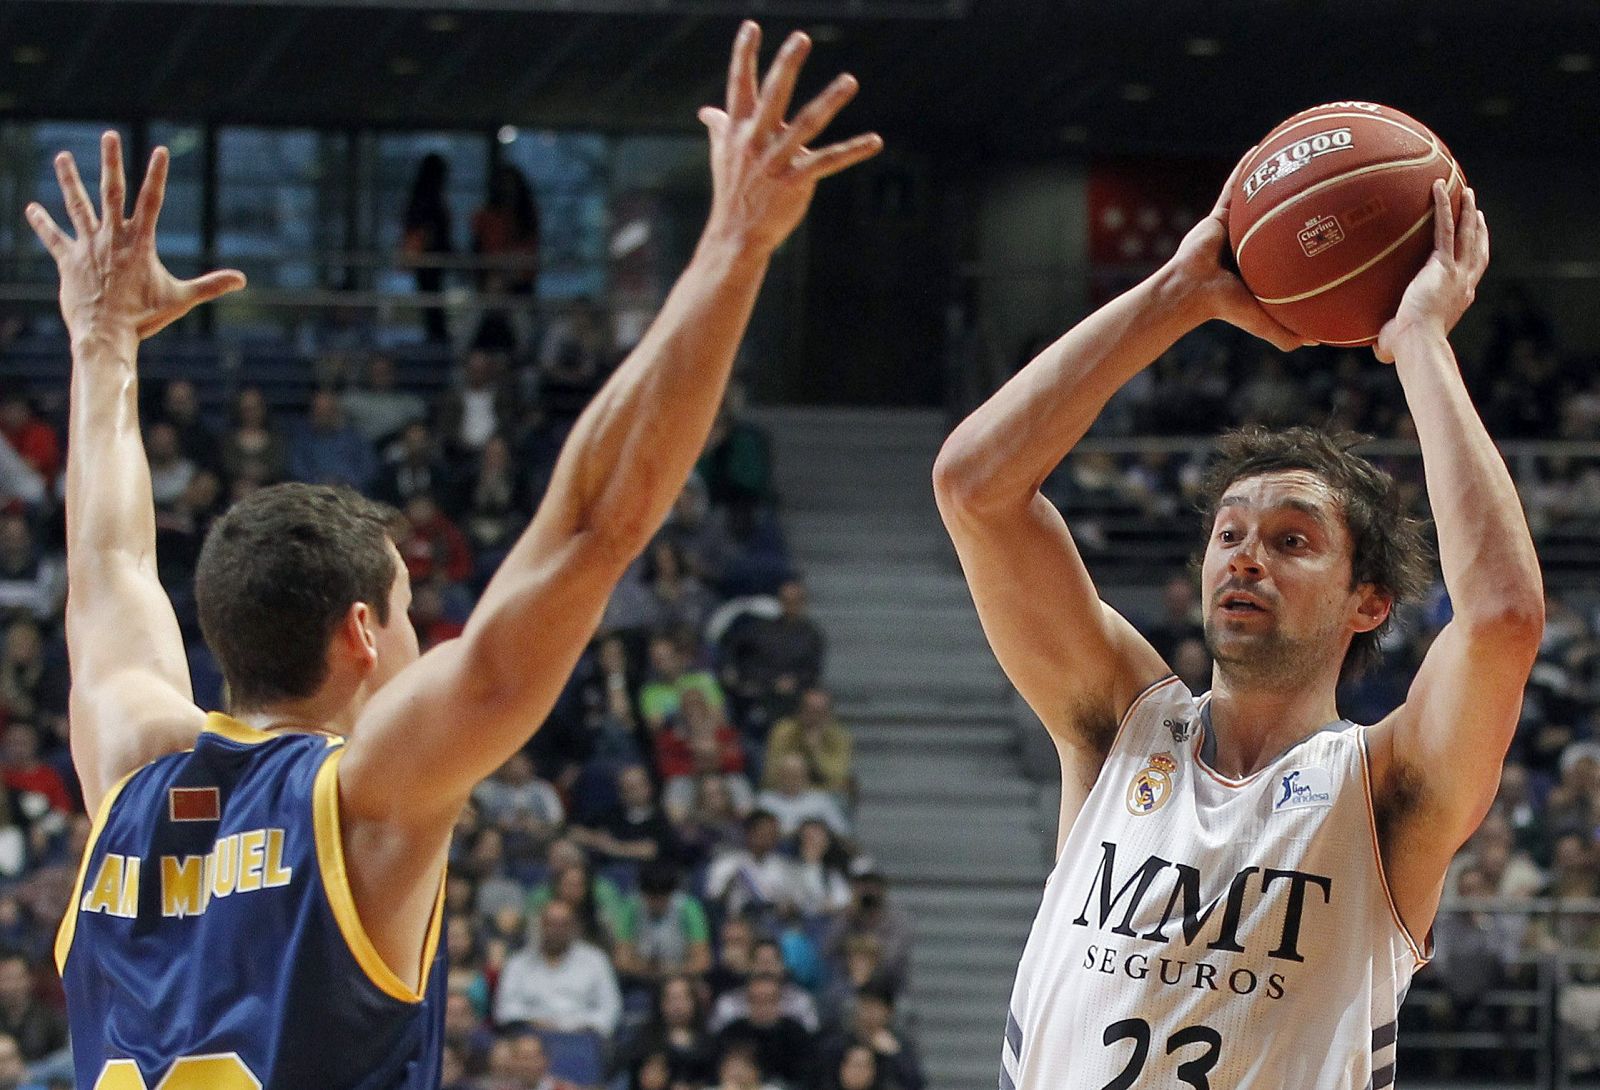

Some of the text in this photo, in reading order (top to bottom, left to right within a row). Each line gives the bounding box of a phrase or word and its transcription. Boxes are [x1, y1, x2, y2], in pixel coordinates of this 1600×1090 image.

[1243, 131, 1352, 198] TF-1000
[1301, 220, 1334, 241] Clarino
[1073, 841, 1332, 963] MMT
[1082, 944, 1285, 1000] SEGUROS
